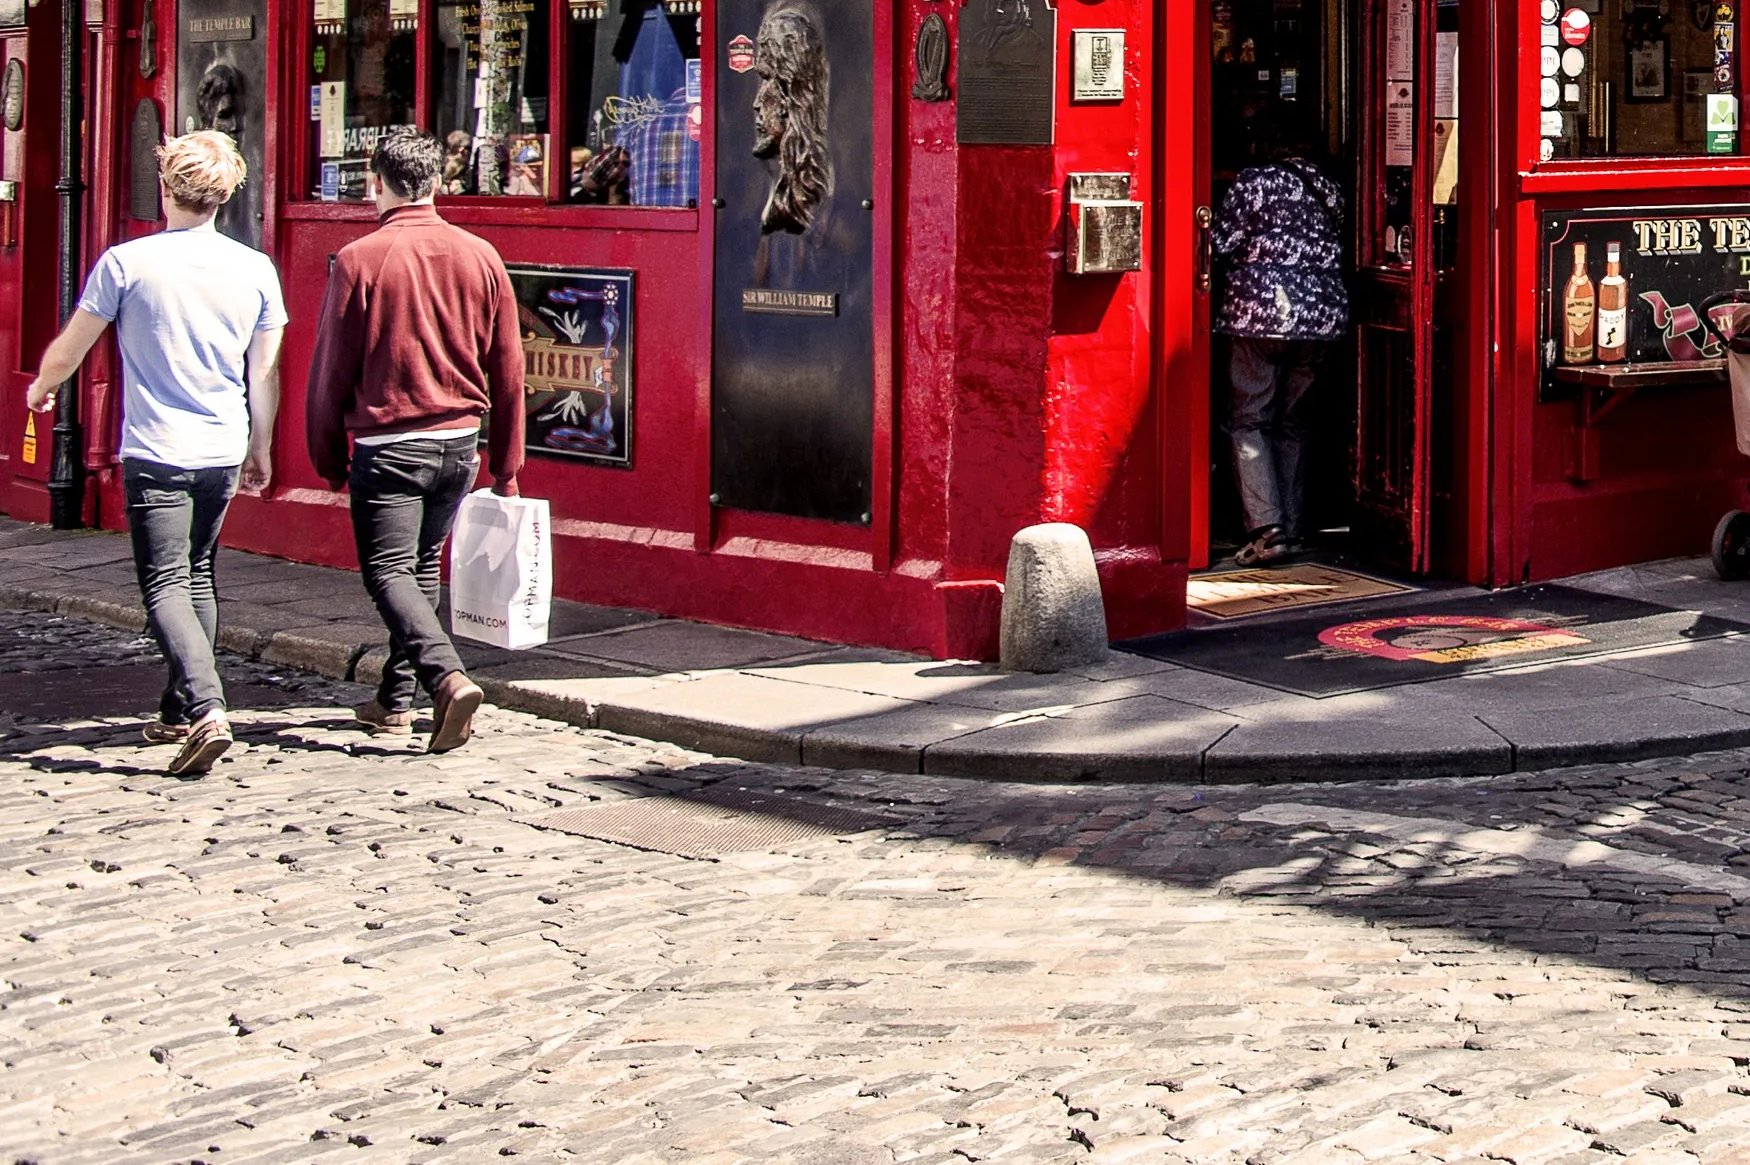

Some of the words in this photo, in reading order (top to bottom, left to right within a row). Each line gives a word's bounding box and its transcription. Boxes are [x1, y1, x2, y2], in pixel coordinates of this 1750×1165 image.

[1633, 219, 1702, 255] THE
[743, 291, 756, 303] SIR
[757, 292, 796, 305] WILLIAM
[797, 294, 833, 308] TEMPLE
[526, 351, 594, 381] HISKEY
